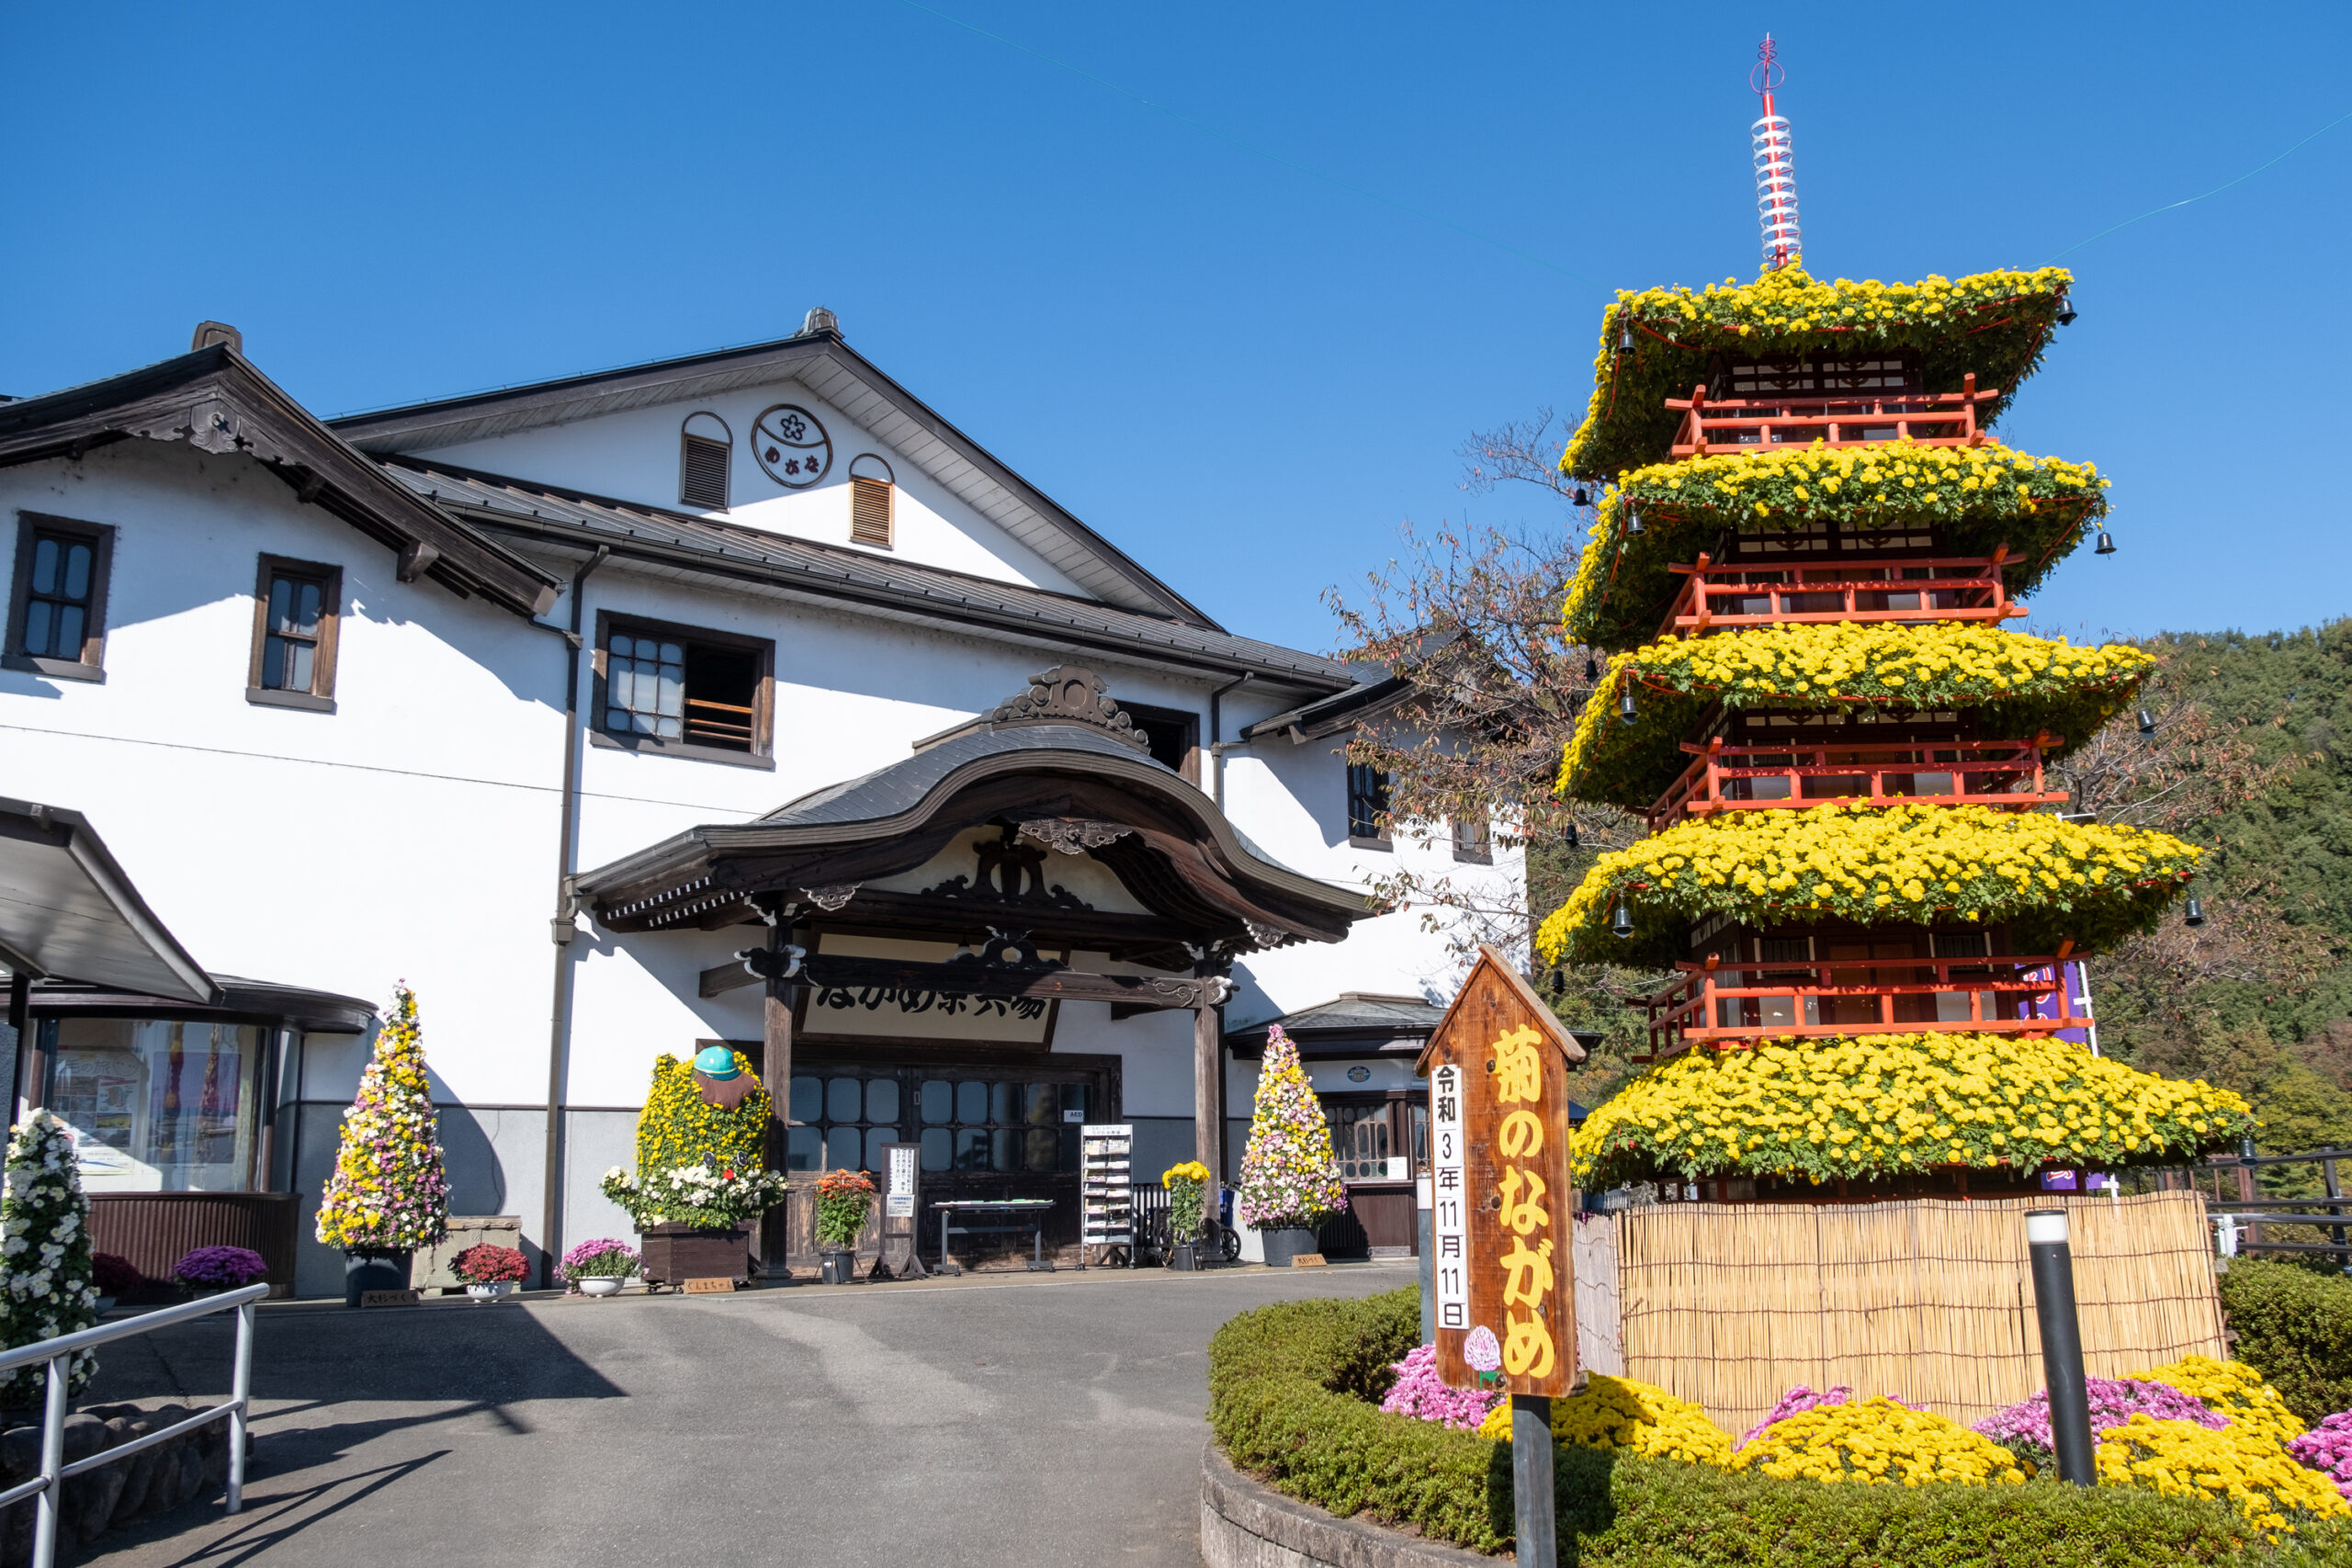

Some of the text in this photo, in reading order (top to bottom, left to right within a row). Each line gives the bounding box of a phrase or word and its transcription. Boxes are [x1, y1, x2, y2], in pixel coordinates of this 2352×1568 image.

[1436, 1066, 1463, 1326] 令和3年11月11日
[1491, 1023, 1555, 1379] 菊のながめ
